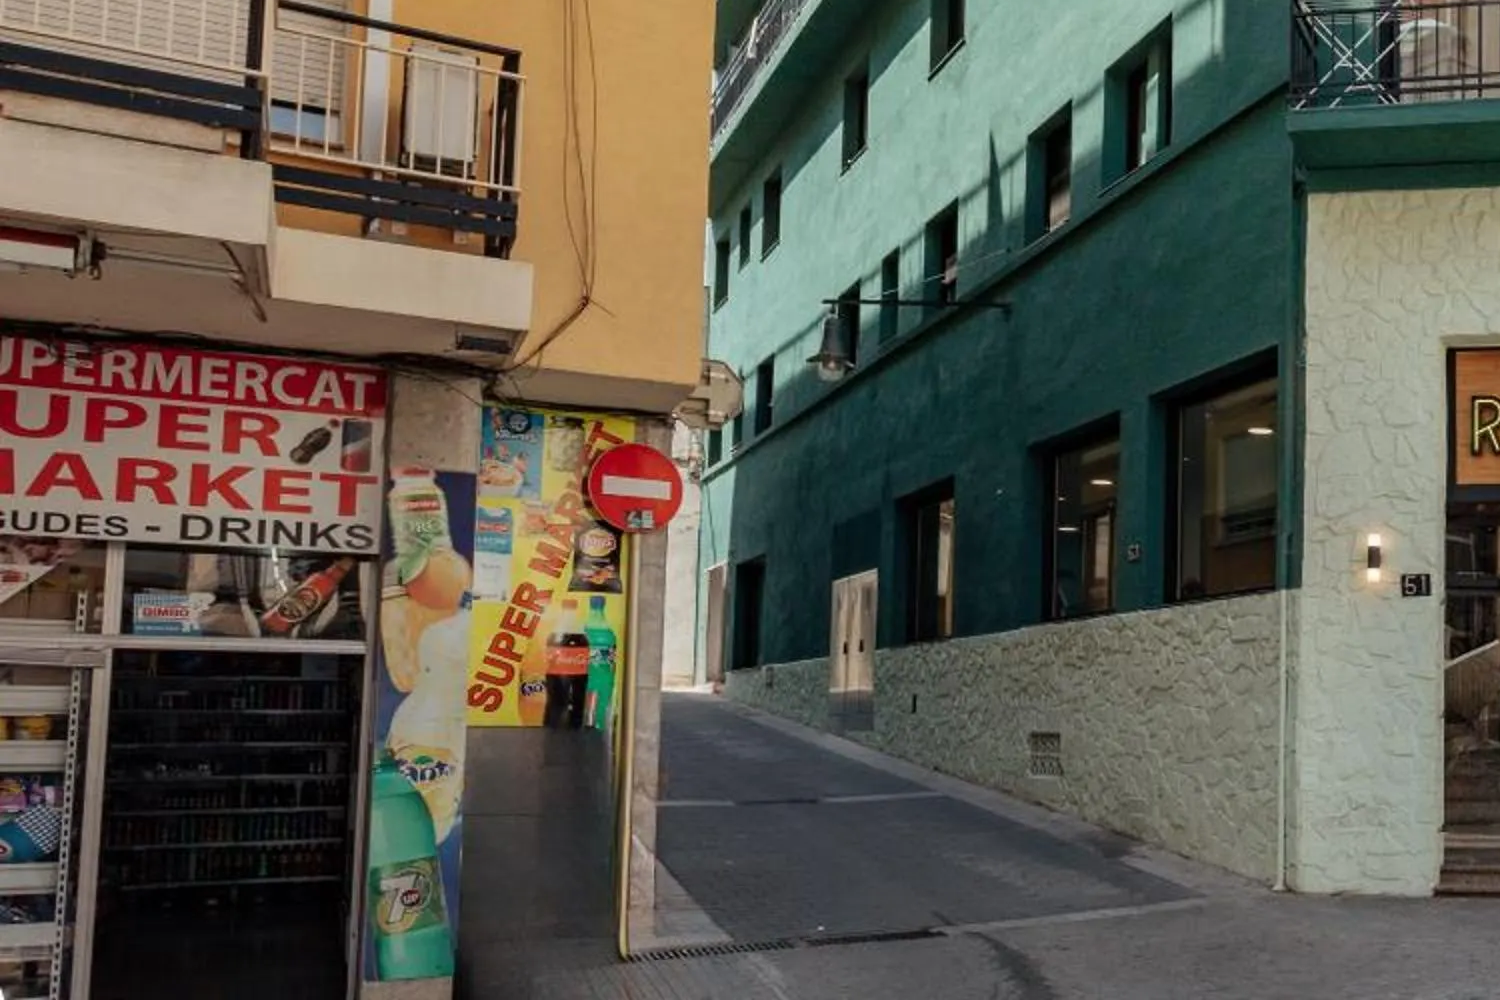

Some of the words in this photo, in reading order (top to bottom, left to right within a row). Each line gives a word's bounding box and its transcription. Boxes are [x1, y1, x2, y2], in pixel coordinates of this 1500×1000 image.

[0, 448, 378, 517] ARKET
[0, 509, 129, 537] UDES
[180, 514, 374, 549] DRINKS
[1405, 575, 1427, 595] 51
[467, 581, 553, 713] SUPER
